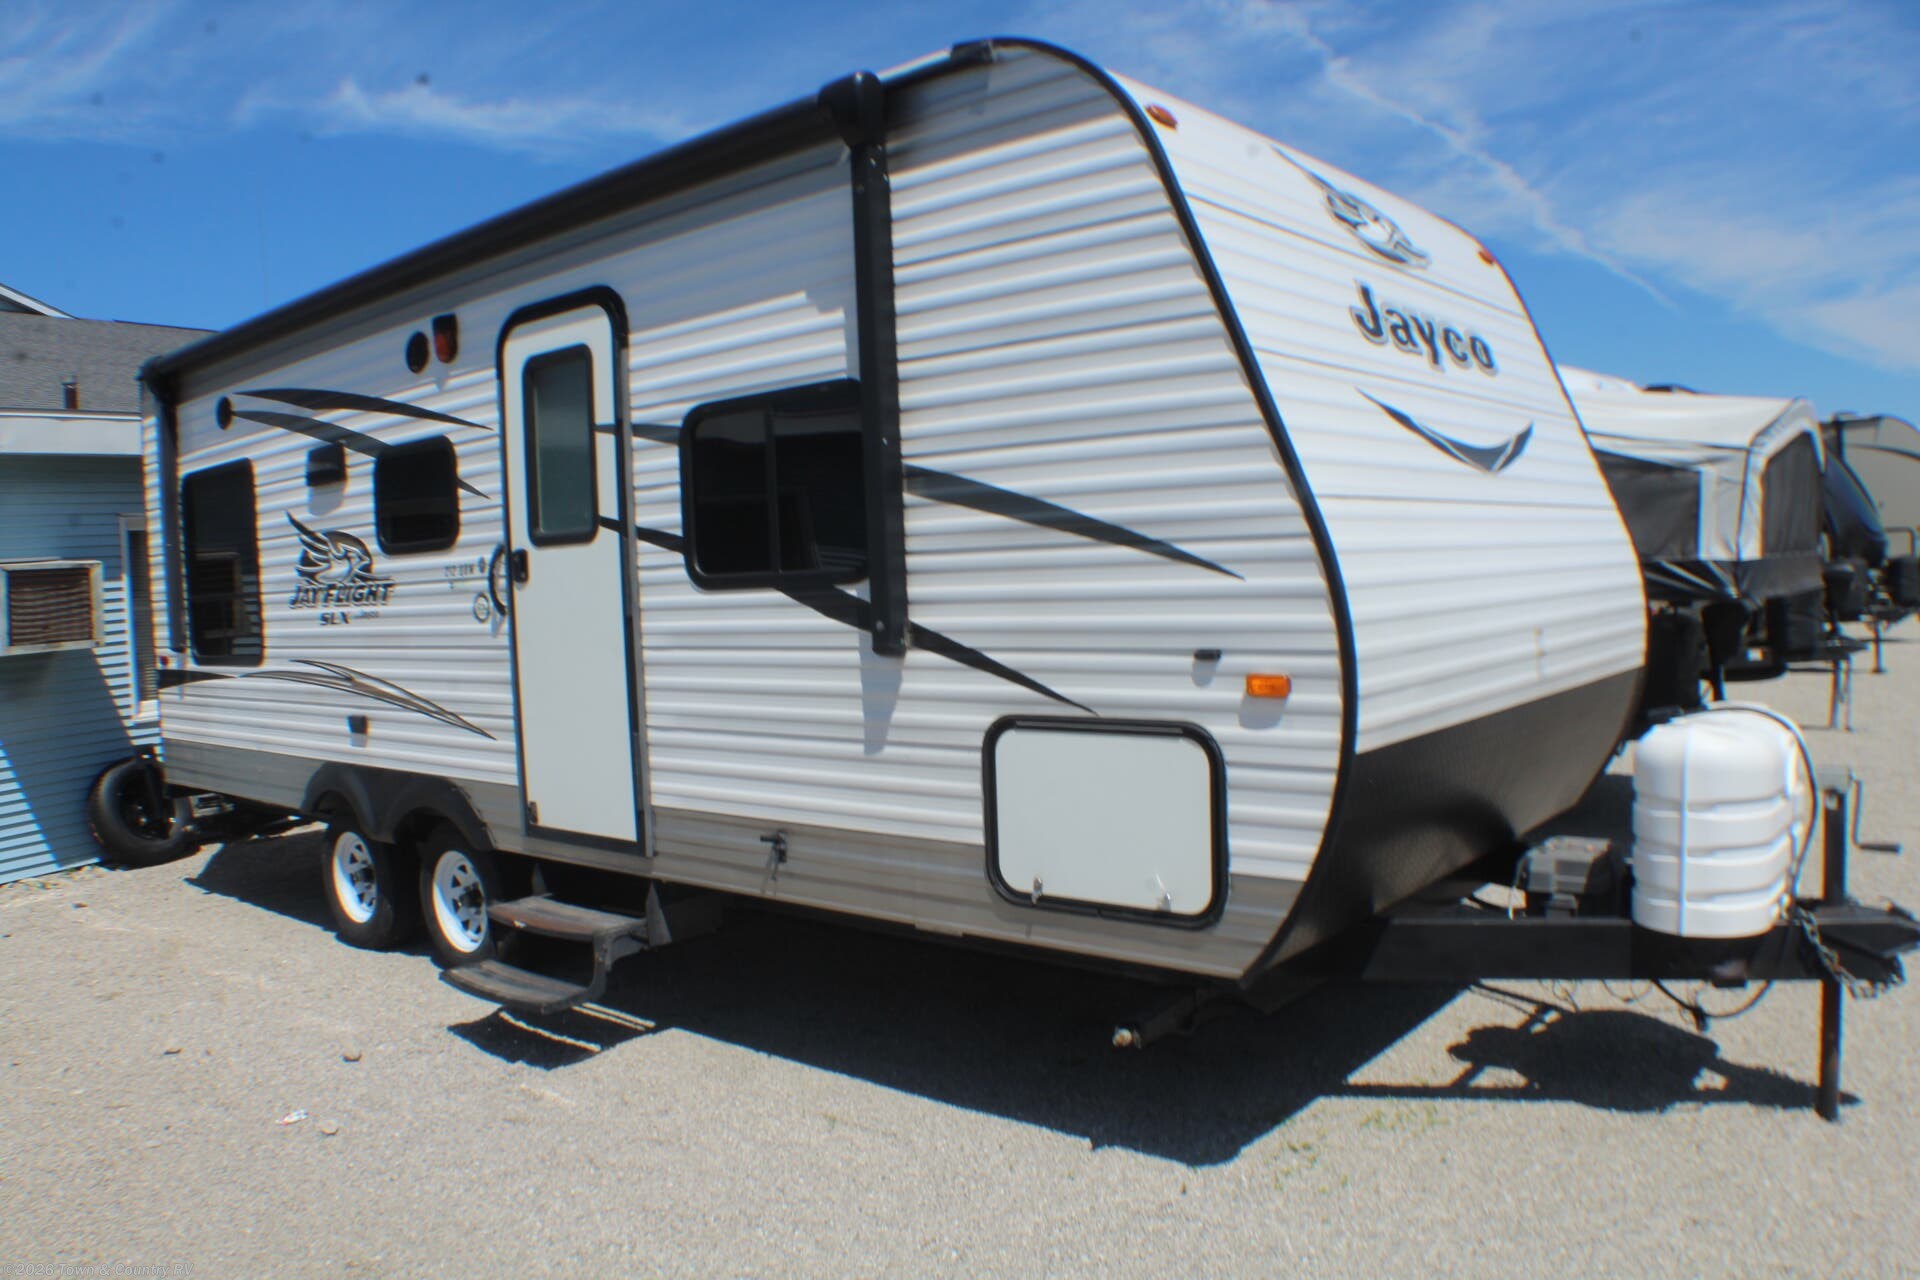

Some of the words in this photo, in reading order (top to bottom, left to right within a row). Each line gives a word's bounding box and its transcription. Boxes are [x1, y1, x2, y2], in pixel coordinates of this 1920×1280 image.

[1352, 282, 1496, 372] Jayco
[289, 585, 320, 609] JAY
[322, 583, 395, 607] FLIGHT
[320, 611, 350, 625] SLX
